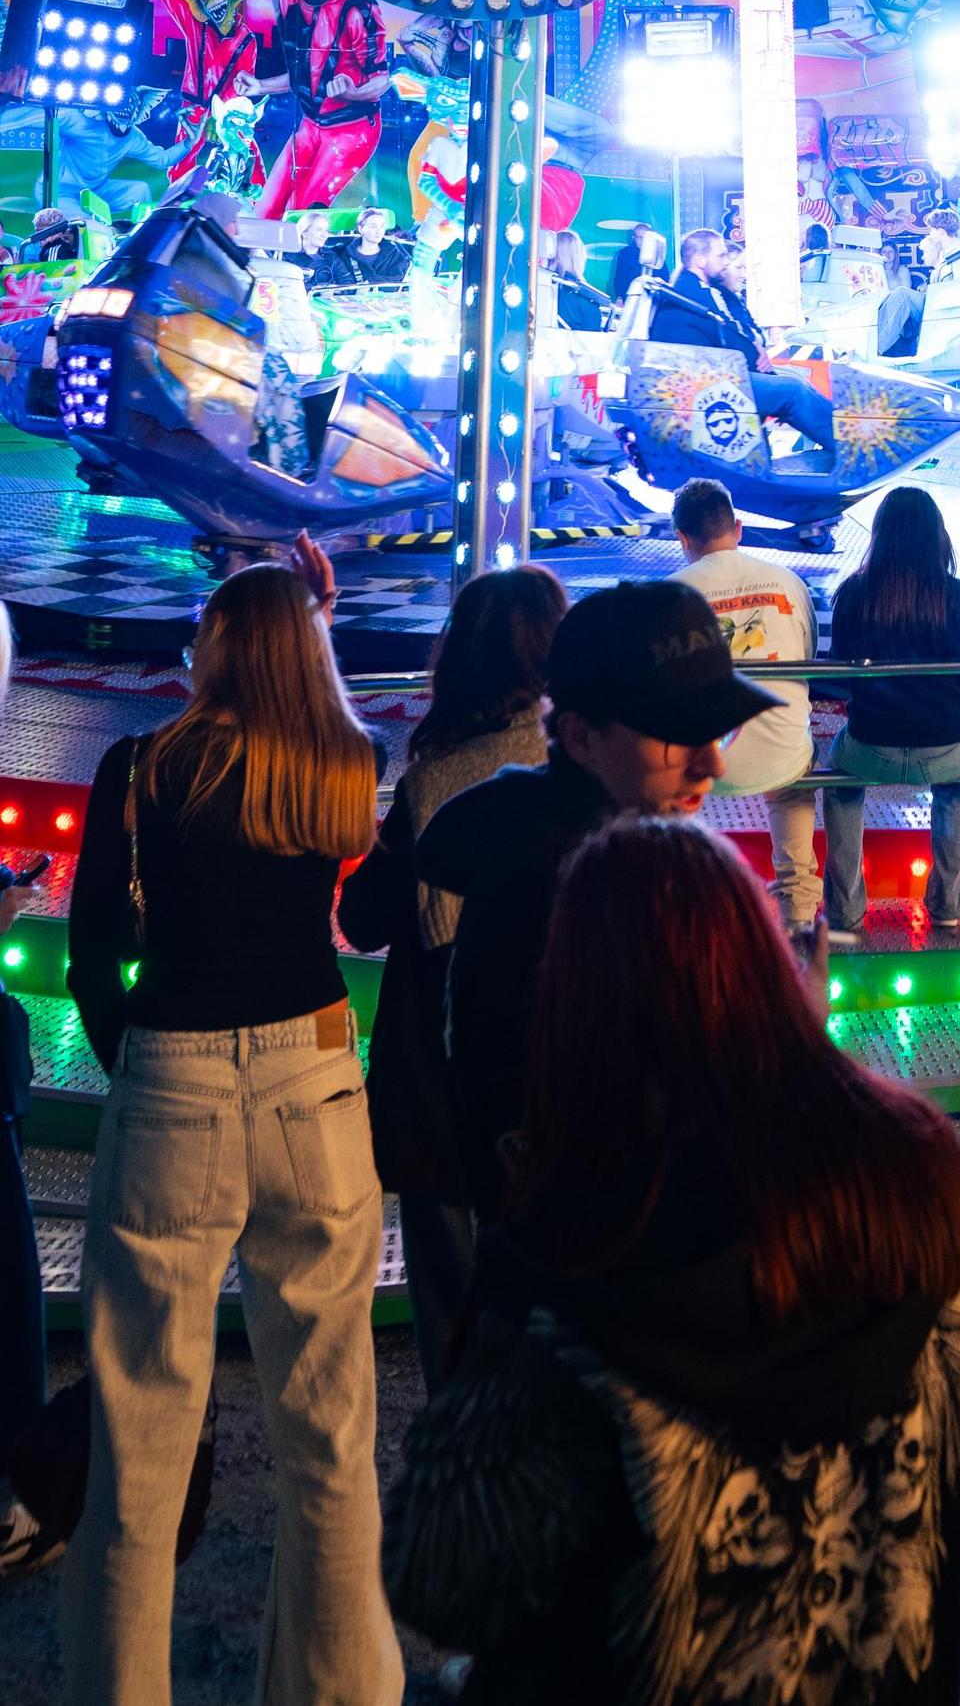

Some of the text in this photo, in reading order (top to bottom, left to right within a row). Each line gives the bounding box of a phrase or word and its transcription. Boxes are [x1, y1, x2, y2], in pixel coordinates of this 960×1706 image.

[720, 390, 746, 407] MAN
[704, 582, 779, 599] ISTERED TRADEMARK
[711, 595, 776, 611] ARL KANI
